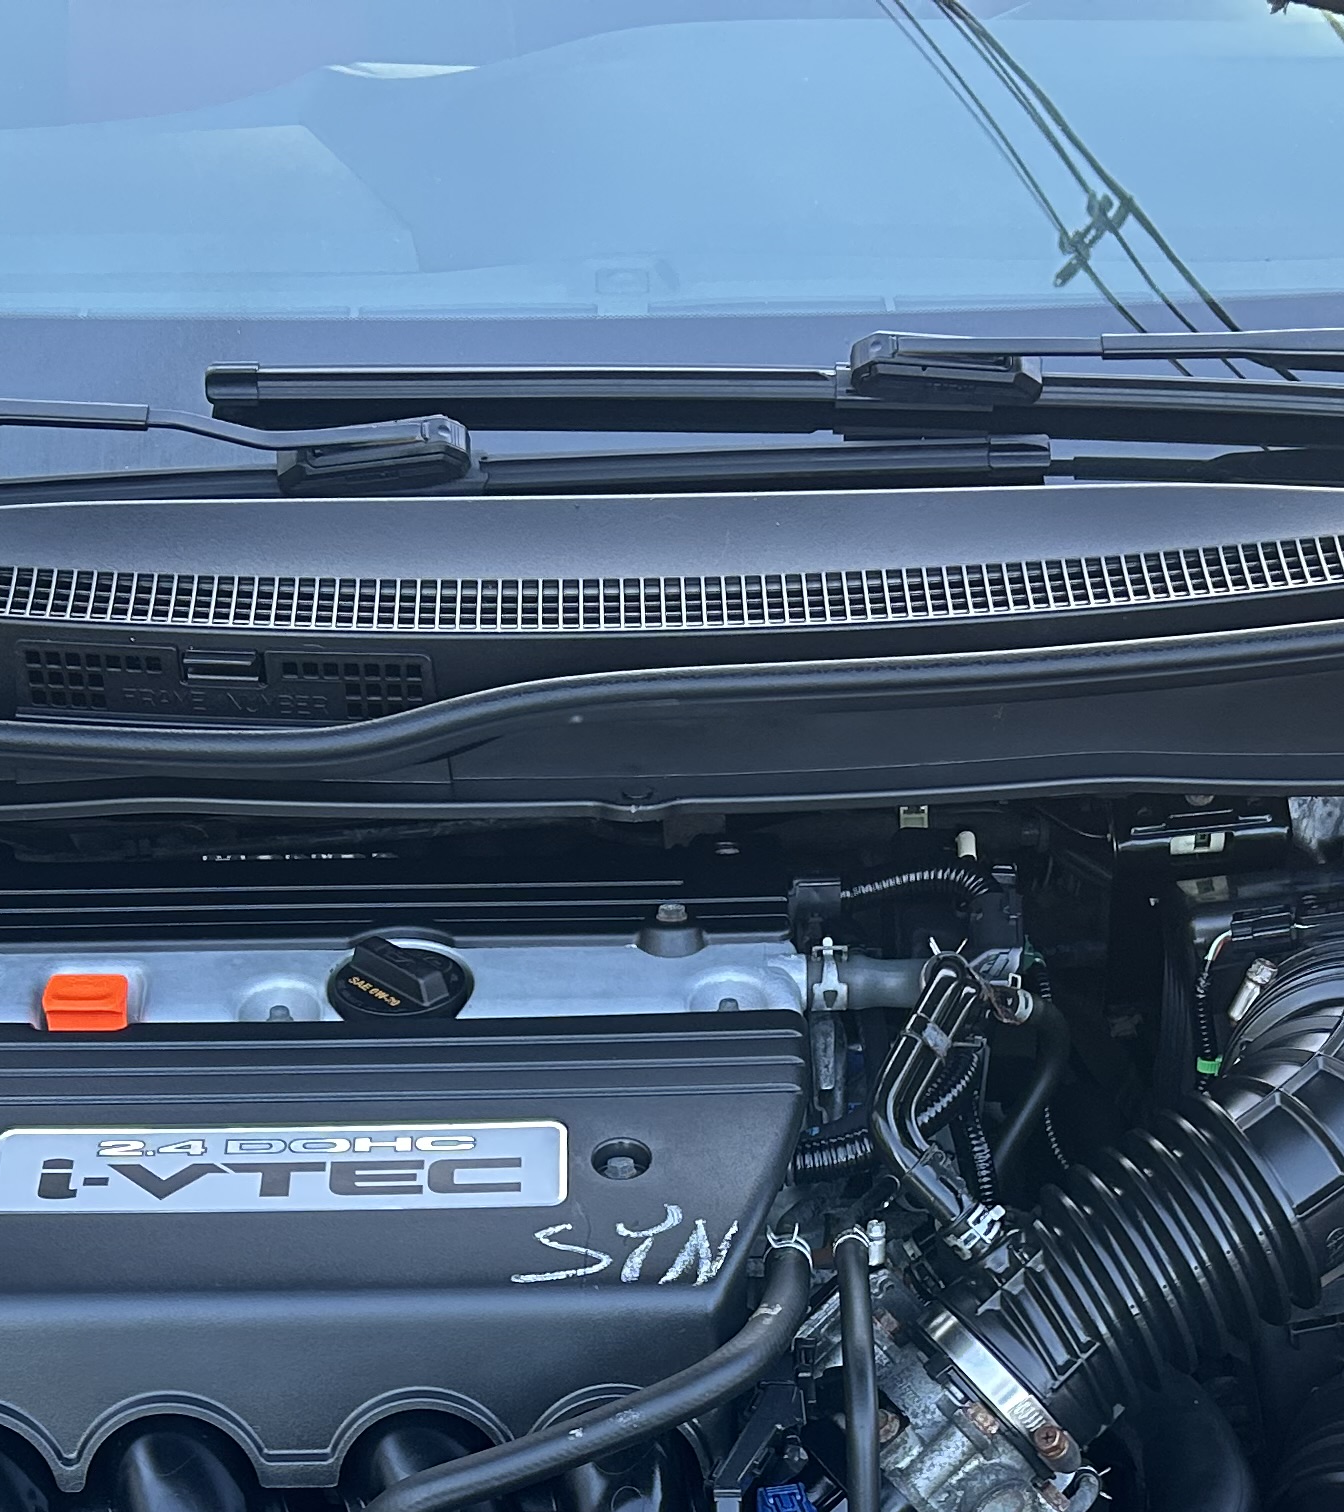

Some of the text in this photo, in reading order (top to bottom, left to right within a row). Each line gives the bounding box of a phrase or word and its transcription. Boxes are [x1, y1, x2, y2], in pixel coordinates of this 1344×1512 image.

[121, 688, 329, 716] FRAME NUMBER
[348, 976, 374, 992] SAE
[96, 1134, 477, 1157] 2.4 DOHC
[36, 1157, 523, 1201] i-VTEC
[510, 1203, 740, 1288] SYN
